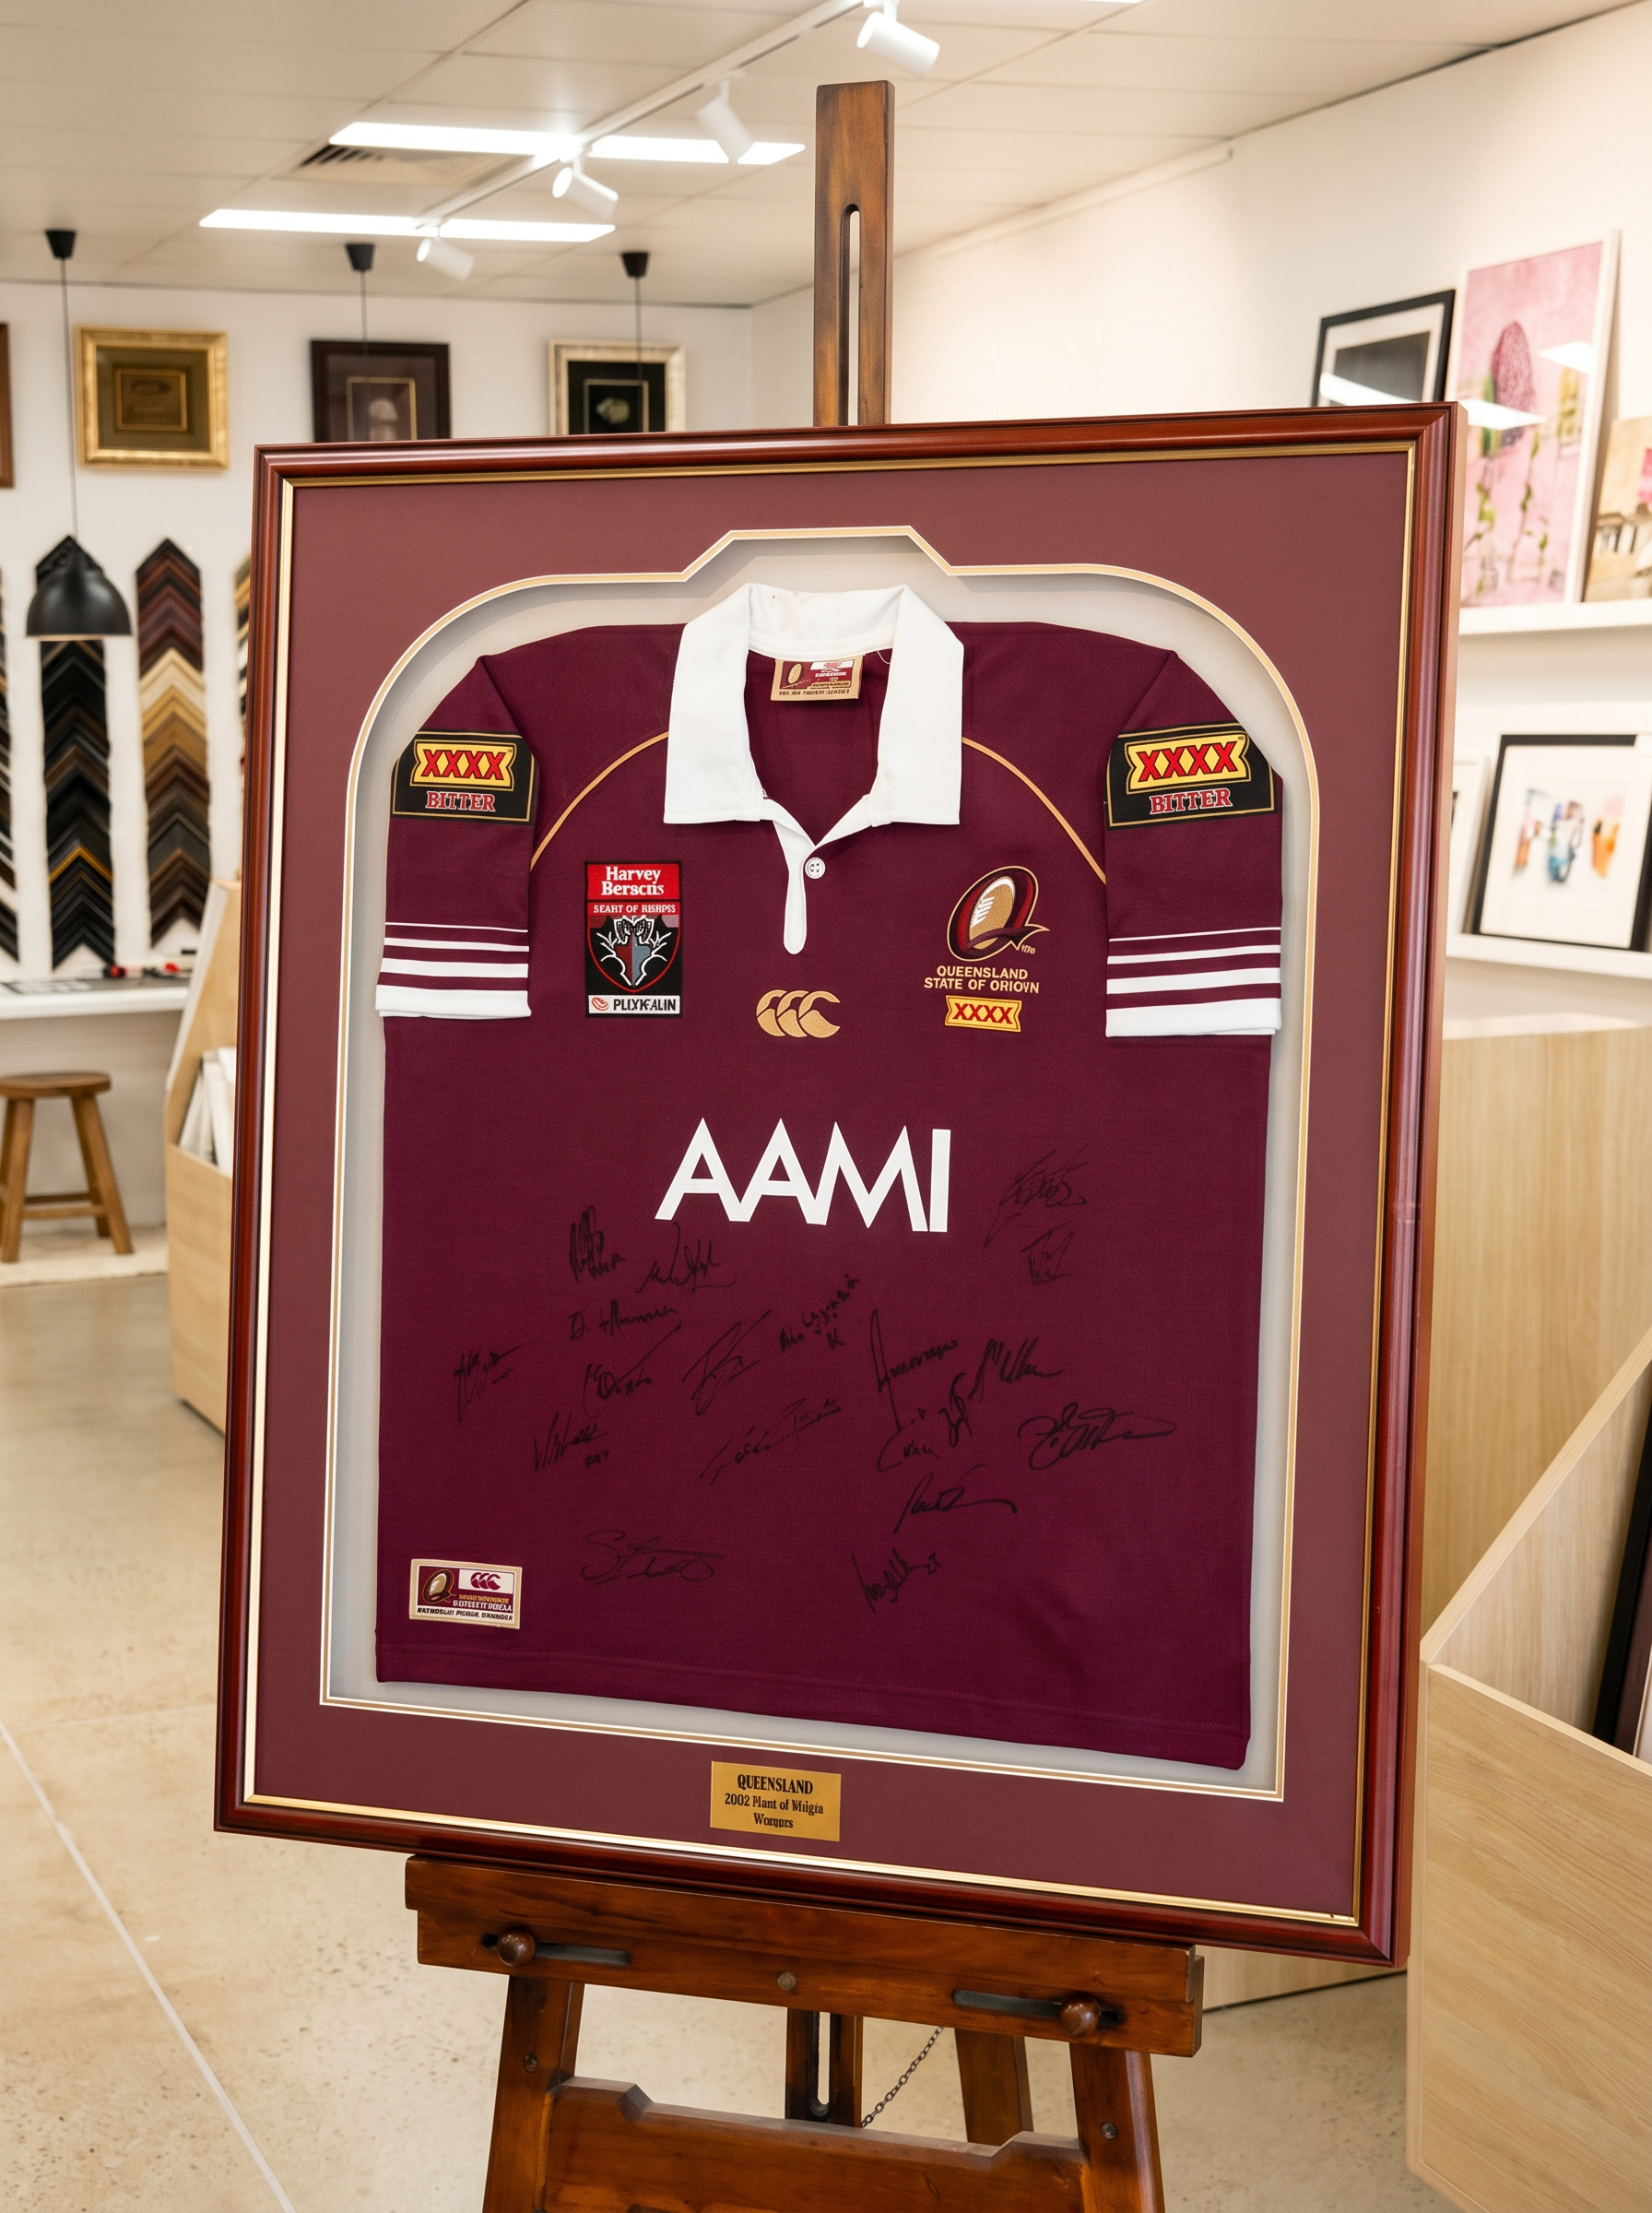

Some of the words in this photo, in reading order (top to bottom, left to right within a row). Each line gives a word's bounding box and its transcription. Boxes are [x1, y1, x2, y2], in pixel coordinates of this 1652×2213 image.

[420, 749, 507, 781] XXXX
[1136, 740, 1239, 783] XXXX
[425, 790, 496, 812] BITTER
[1149, 787, 1233, 815] BITTER
[605, 866, 662, 885] Harvey
[625, 905, 639, 913] OF
[936, 964, 1029, 980] QUEENSLAND
[923, 976, 963, 990] STATE
[967, 978, 986, 991] OF
[951, 1002, 1014, 1025] XXXX
[654, 1117, 951, 1233] AAMI
[737, 1773, 814, 1795] QUEENSLAND
[725, 1793, 750, 1807] 2002
[779, 1798, 790, 1811] of
